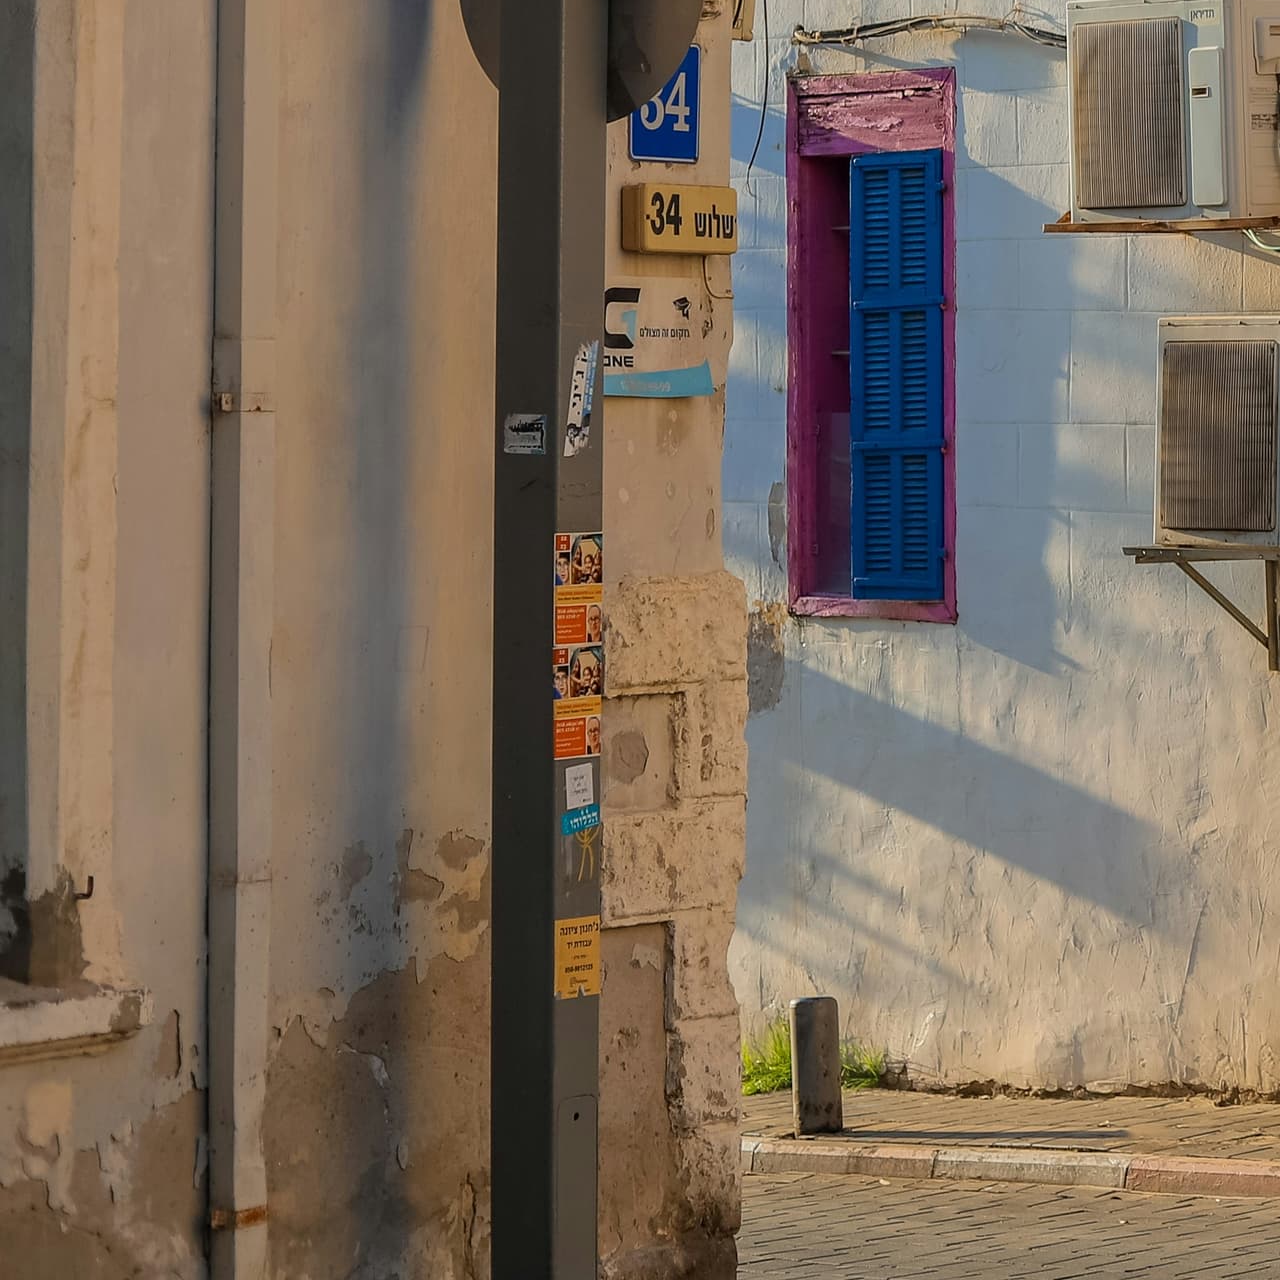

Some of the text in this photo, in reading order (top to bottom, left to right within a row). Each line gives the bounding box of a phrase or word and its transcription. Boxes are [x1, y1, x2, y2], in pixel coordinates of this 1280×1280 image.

[650, 192, 734, 239] שלוש 34
[640, 326, 660, 338] מצולם
[671, 328, 690, 340] מקום
